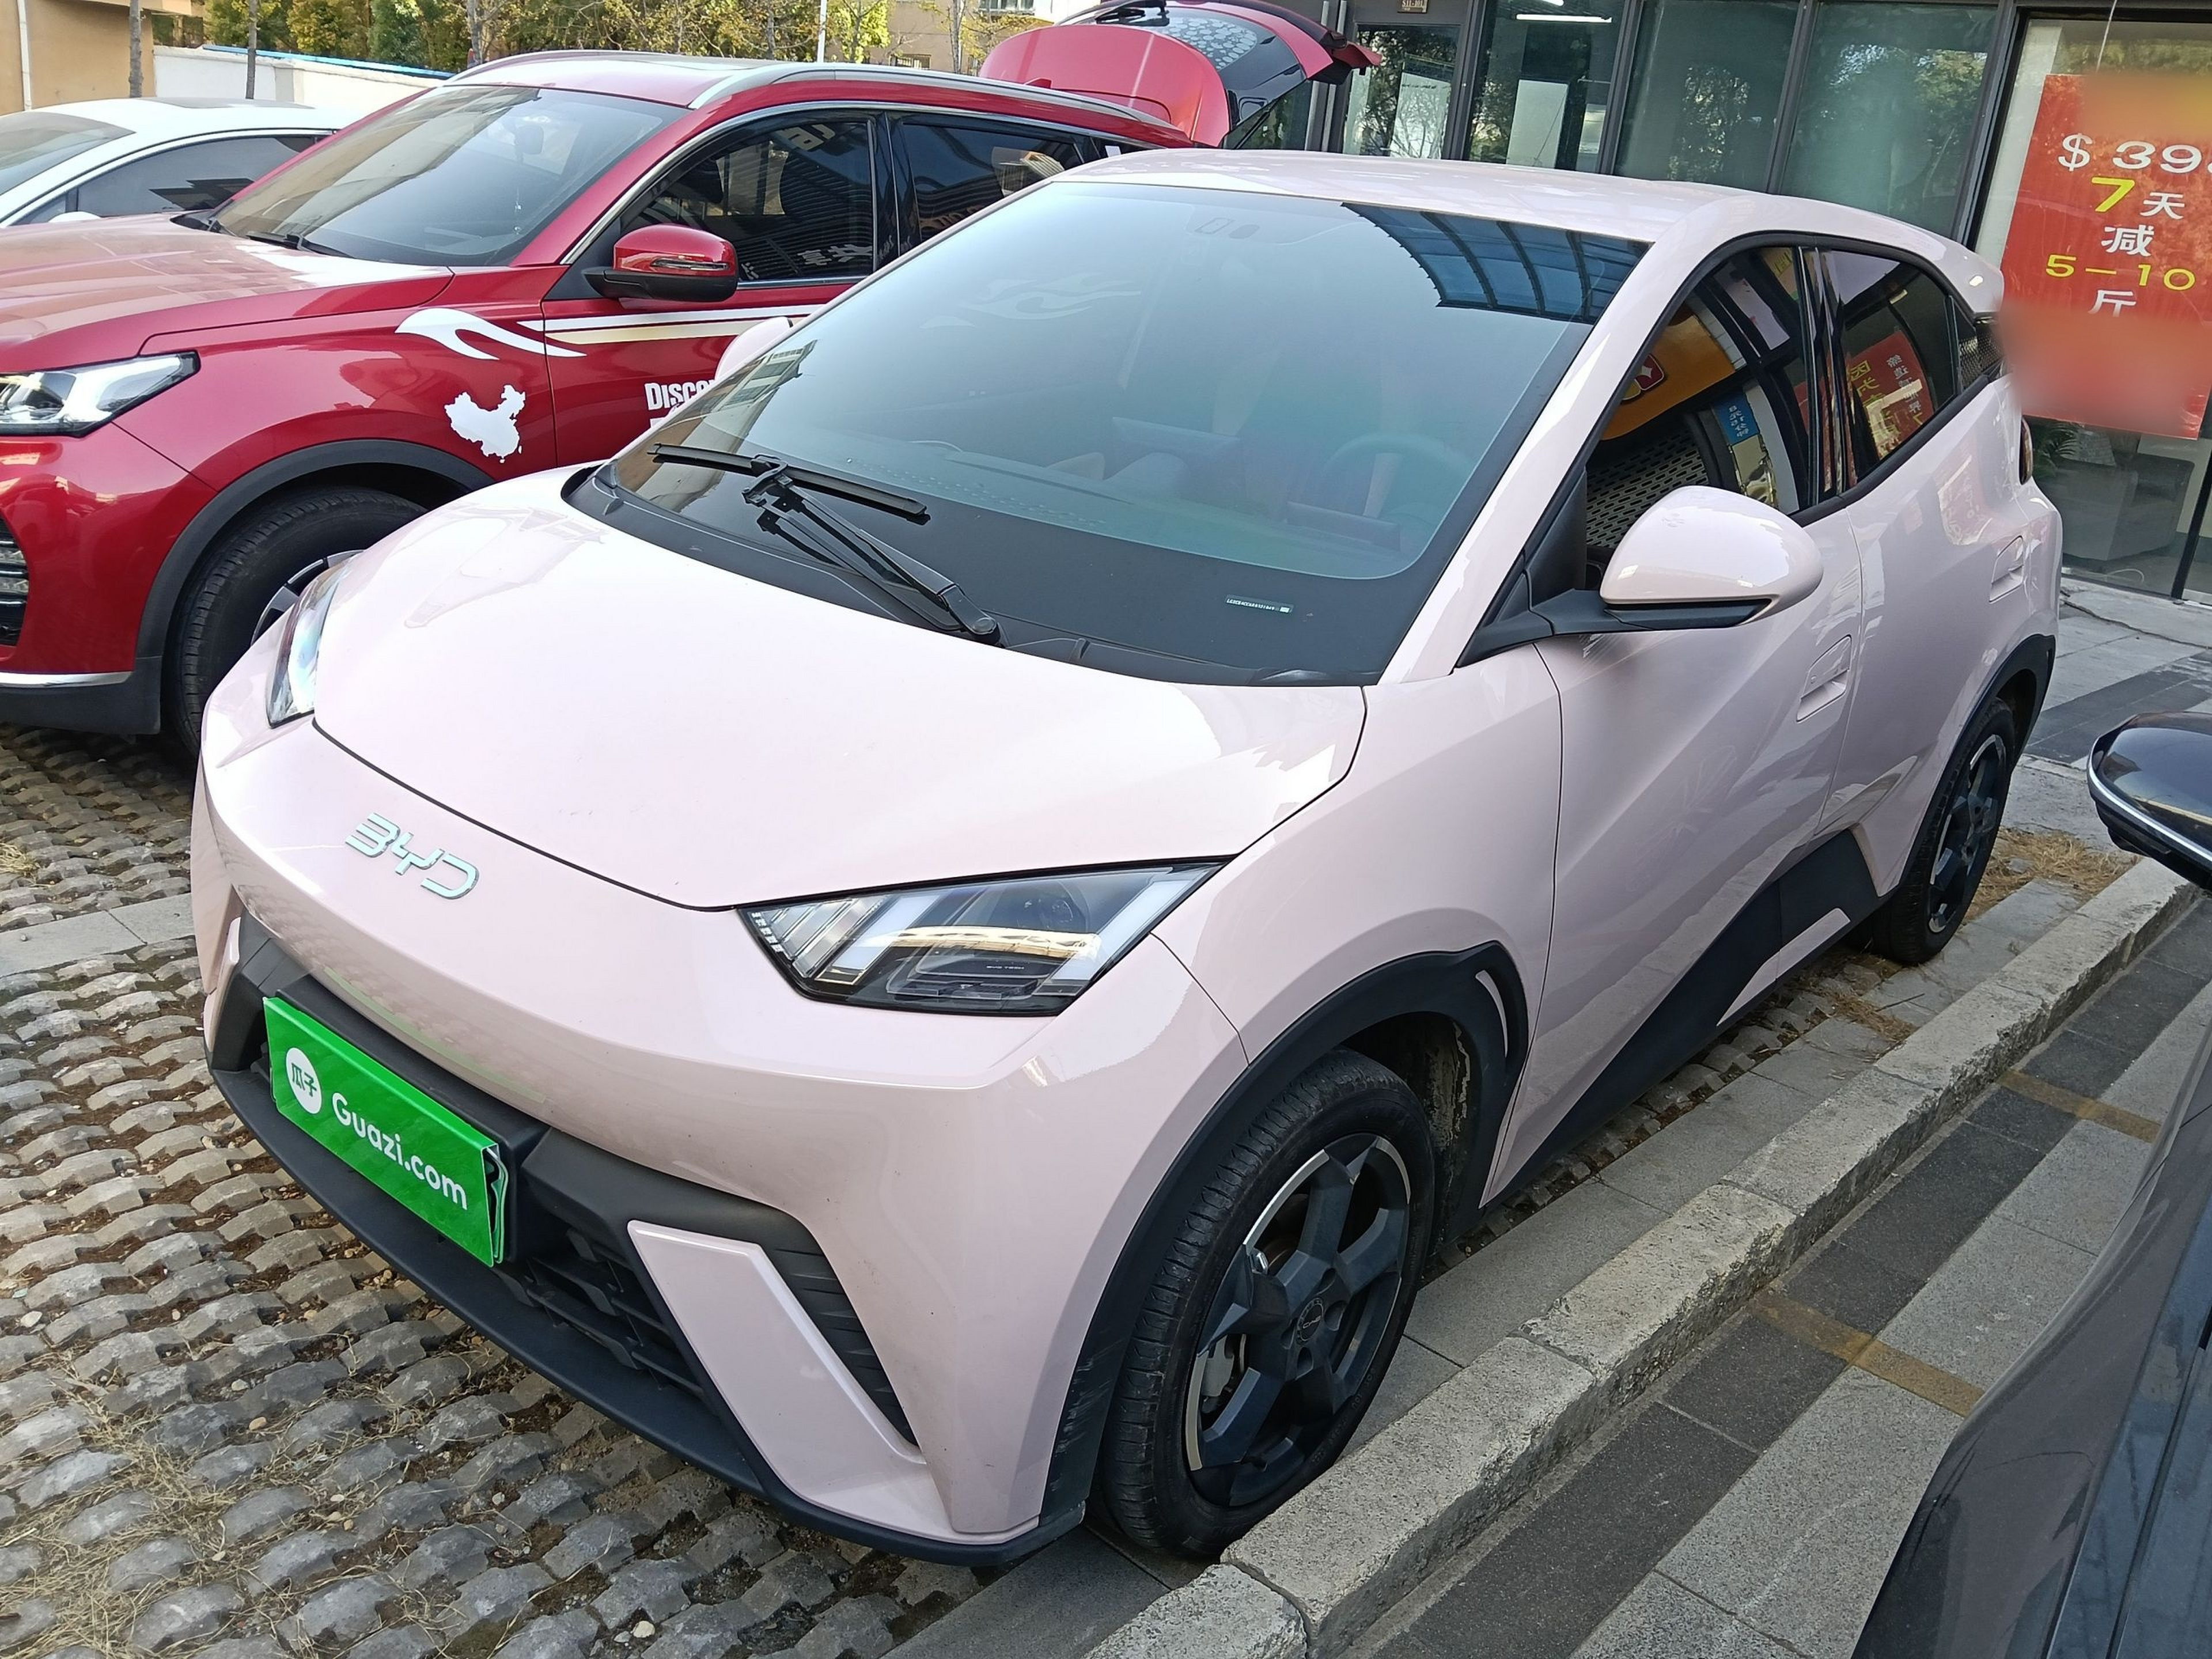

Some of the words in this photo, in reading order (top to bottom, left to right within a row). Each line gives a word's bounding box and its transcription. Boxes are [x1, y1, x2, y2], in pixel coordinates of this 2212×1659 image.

[2112, 141, 2212, 173] 39
[2101, 224, 2154, 257] 减
[2088, 290, 2137, 317] 斤
[346, 812, 479, 899] BYD
[291, 1062, 317, 1097] 瓜子
[332, 1092, 467, 1210] Guazi.com
